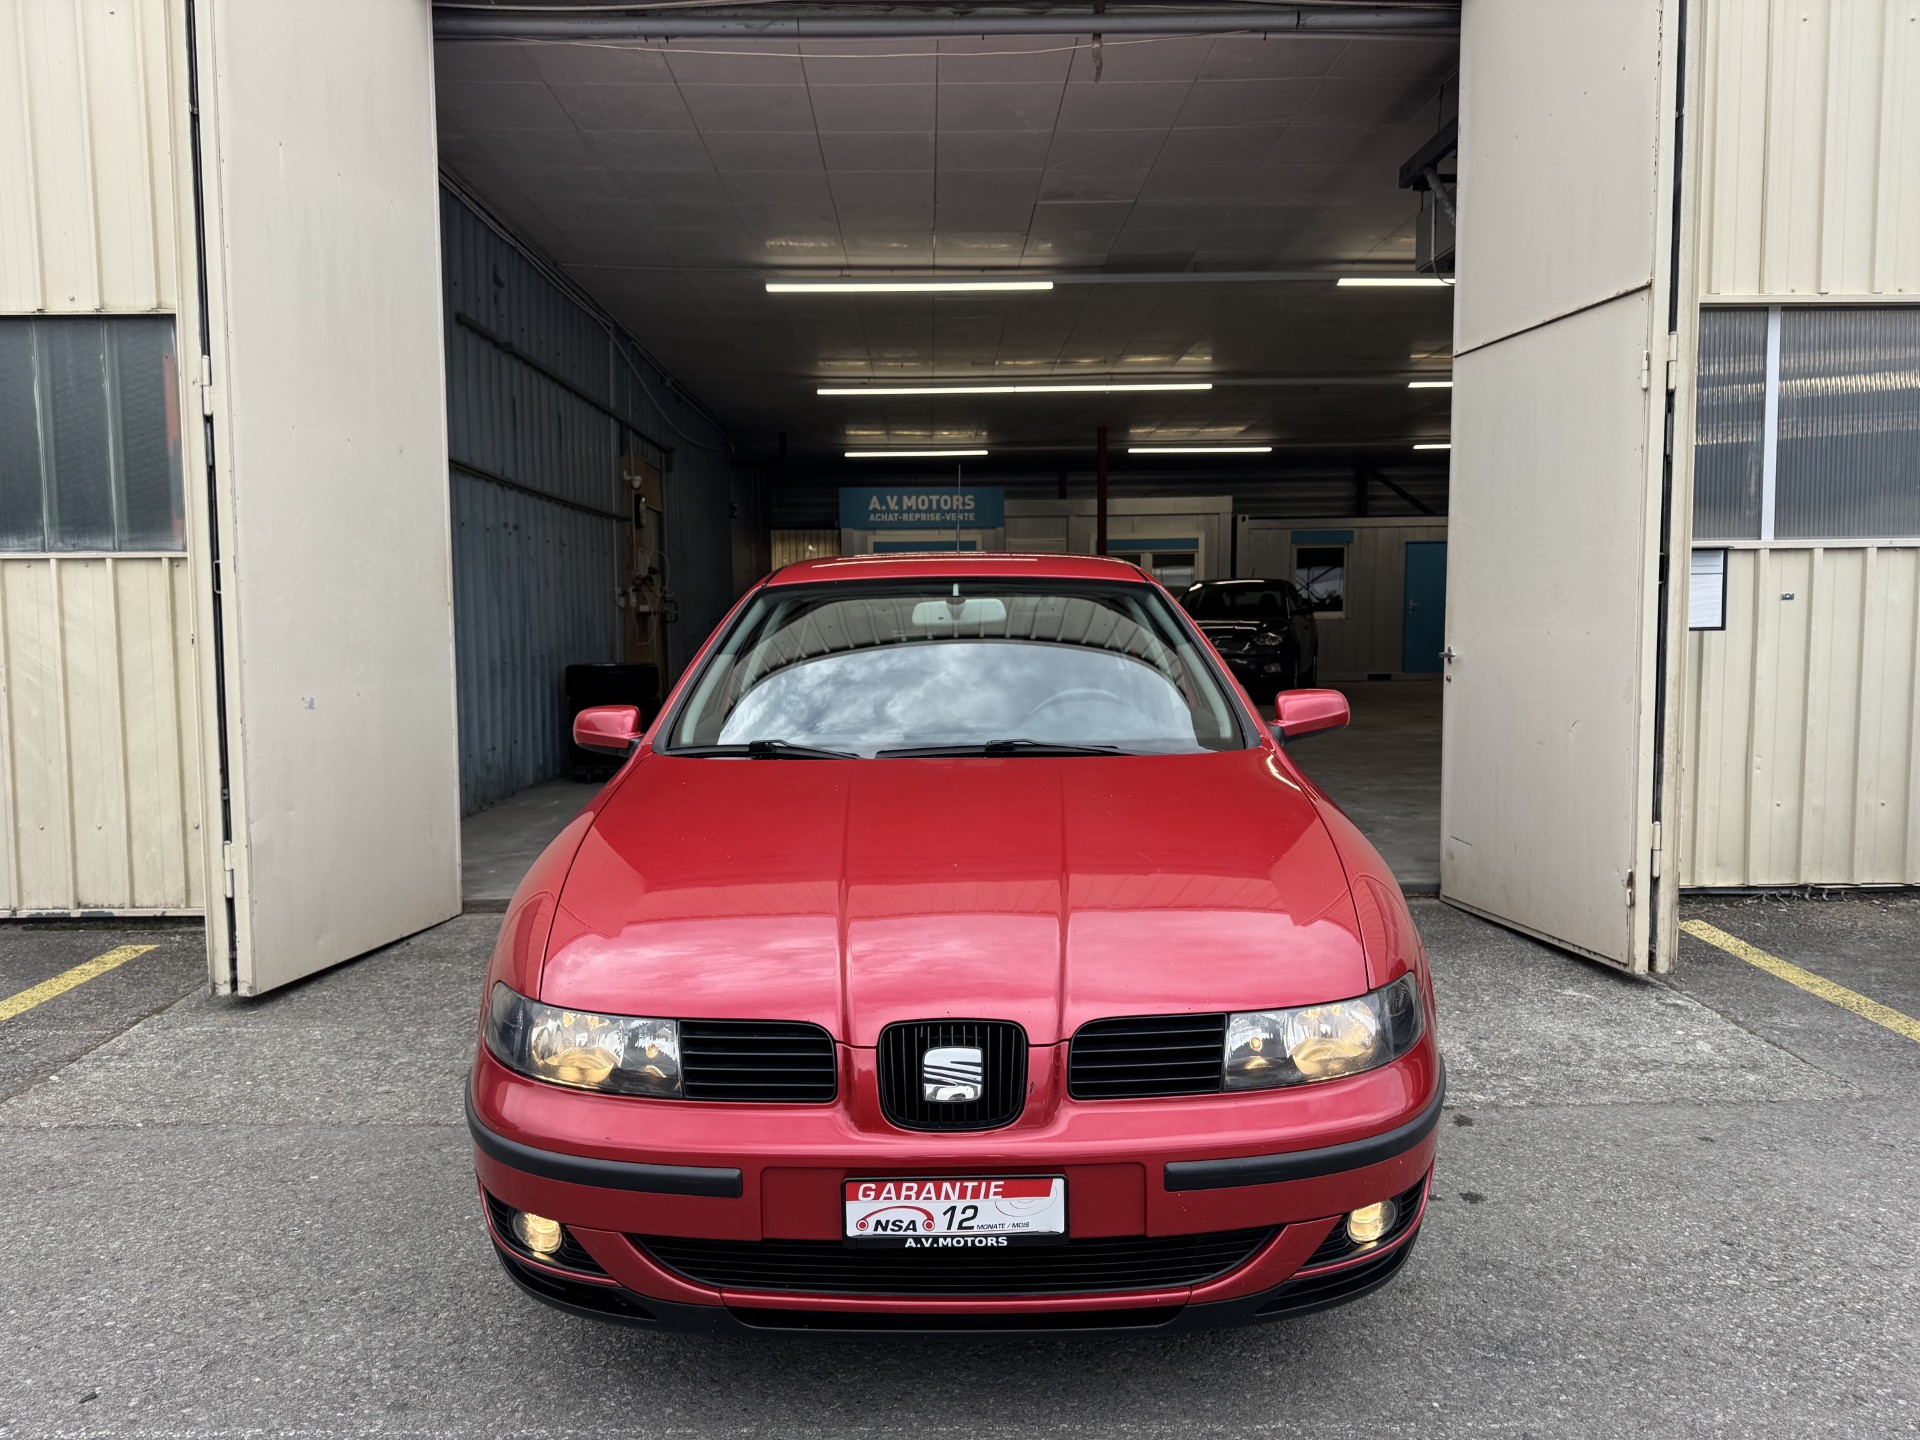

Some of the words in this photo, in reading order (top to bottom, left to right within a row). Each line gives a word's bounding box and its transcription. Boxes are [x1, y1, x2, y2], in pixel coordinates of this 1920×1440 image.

[902, 495, 975, 510] MOTORS
[869, 513, 975, 521] ACHAT-REPRISE-VENTE
[857, 1181, 1005, 1201] GARANTIE
[942, 1205, 979, 1231] 12
[976, 1222, 1006, 1230] MONATE
[1011, 1221, 1030, 1229] MOIS
[873, 1219, 918, 1233] NSA
